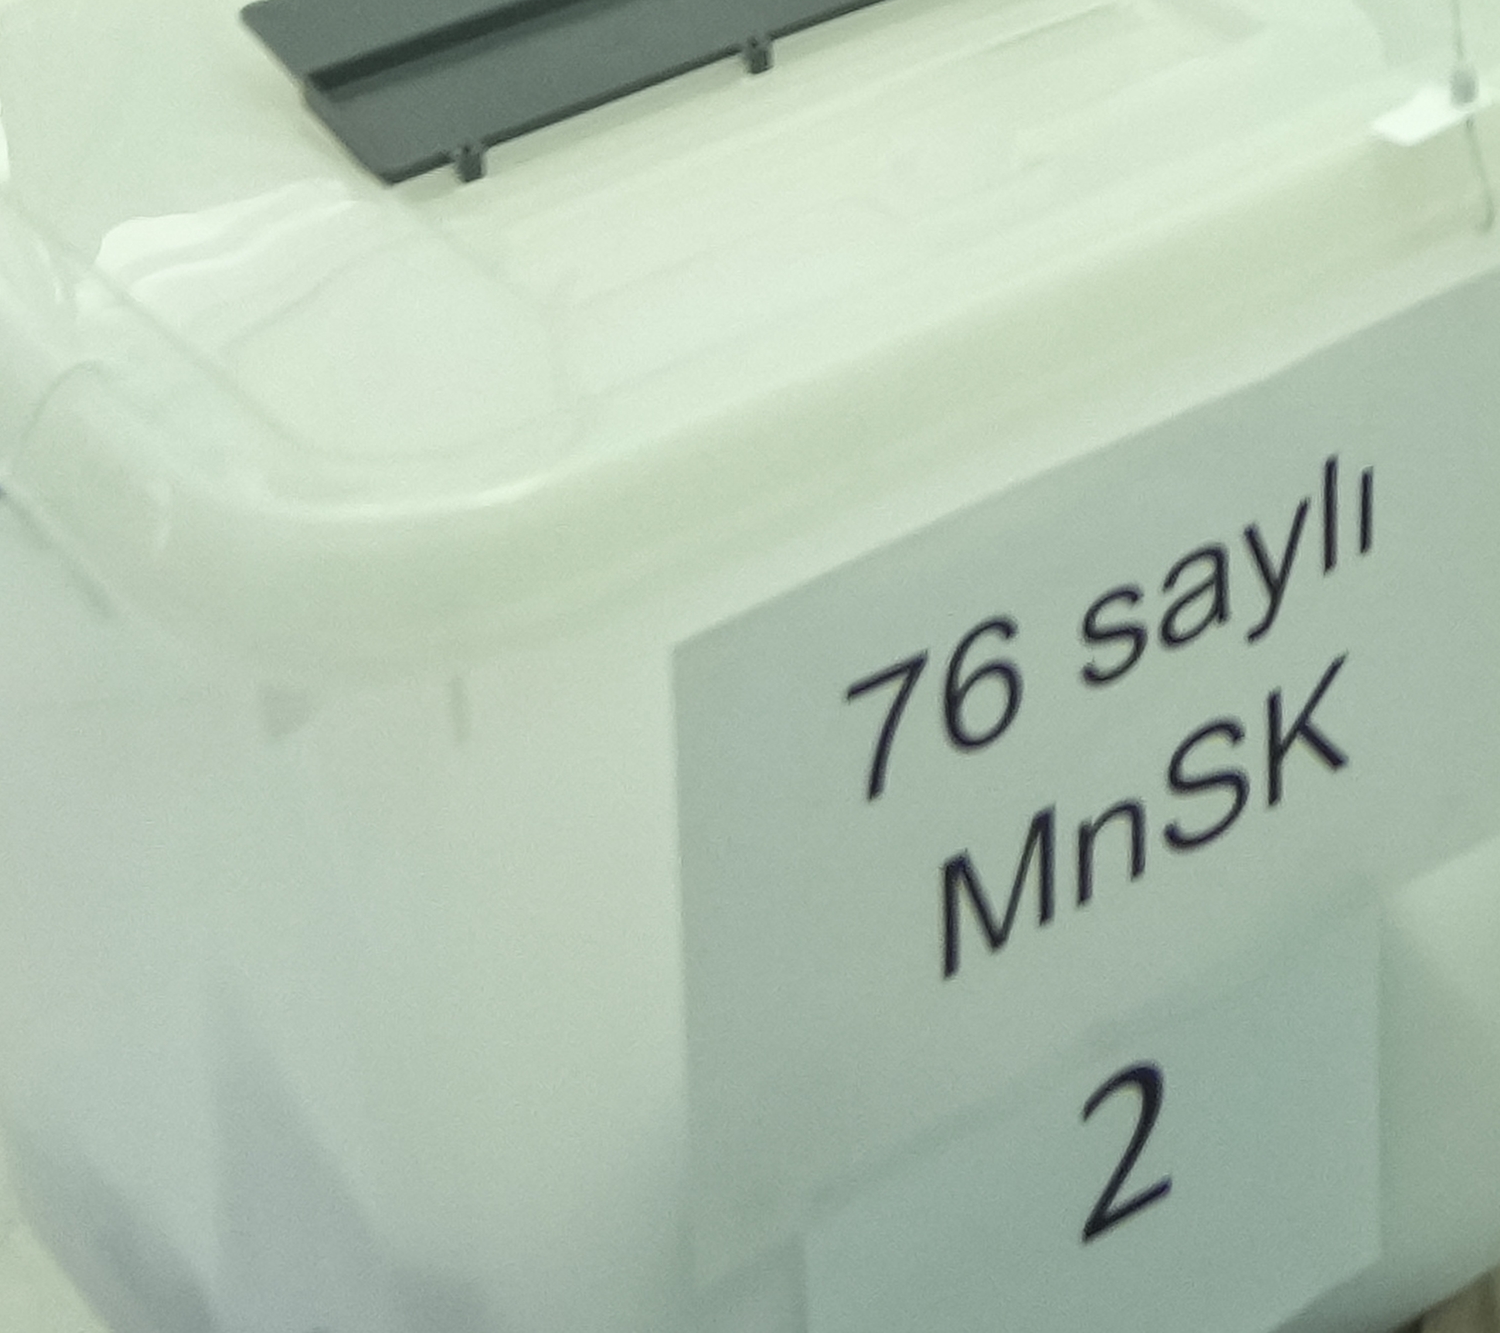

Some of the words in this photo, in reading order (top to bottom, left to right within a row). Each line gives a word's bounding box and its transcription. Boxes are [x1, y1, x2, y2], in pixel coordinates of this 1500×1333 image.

[844, 615, 1024, 803] 76
[1080, 453, 1376, 688] saylı
[939, 649, 1352, 981] MnSK
[1079, 1060, 1175, 1246] 2
